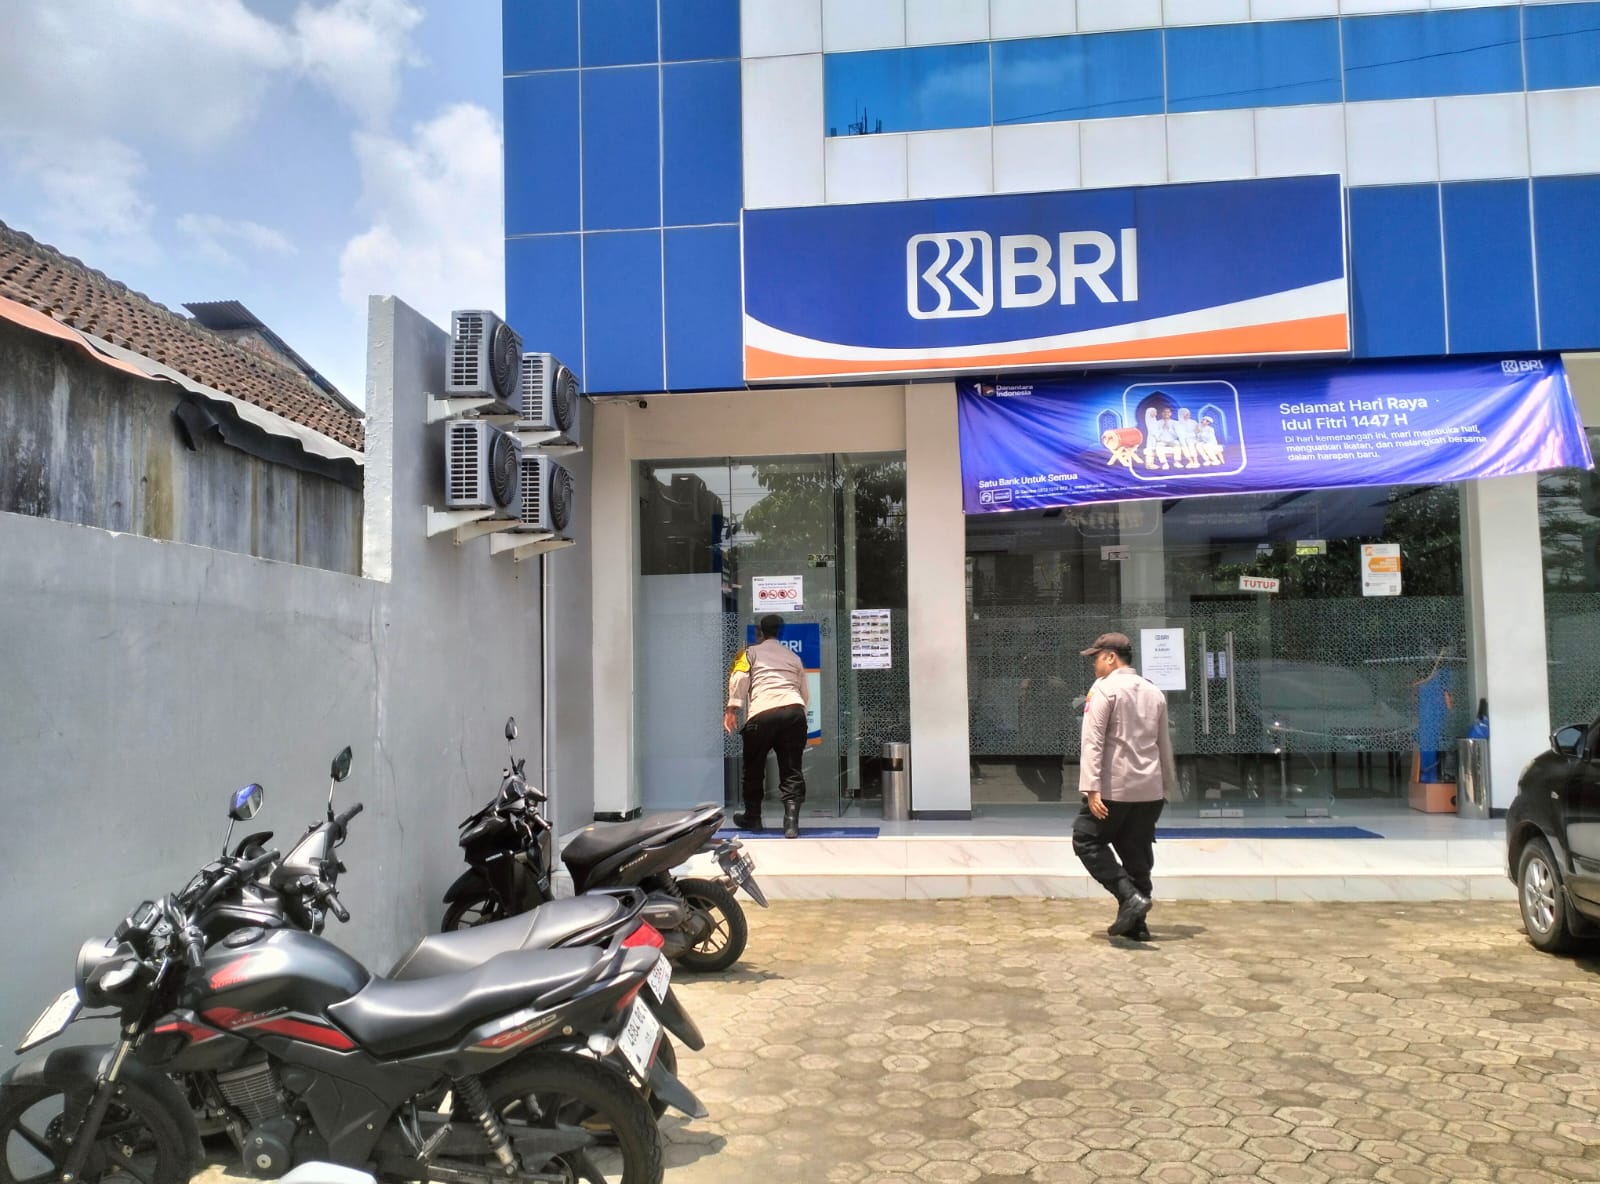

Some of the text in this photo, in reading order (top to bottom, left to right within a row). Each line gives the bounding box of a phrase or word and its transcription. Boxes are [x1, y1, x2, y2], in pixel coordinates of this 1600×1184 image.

[999, 228, 1139, 309] BRI
[1518, 360, 1544, 372] BRI
[996, 390, 1032, 398] Indonesia
[1279, 396, 1428, 415] Selamat Hari Raya
[1281, 412, 1408, 431] Idul Fitri 1447 H
[1284, 424, 1480, 443] Di hari kemenangan ini, mari membuka hati,
[1286, 434, 1487, 454] menguatkan ikatan, dan melangkah bersama
[1287, 453, 1316, 461] dalam
[1317, 450, 1355, 461] harapan
[978, 472, 1078, 489] Satu Bank Untuk Semua
[1243, 579, 1276, 589] TUTUP
